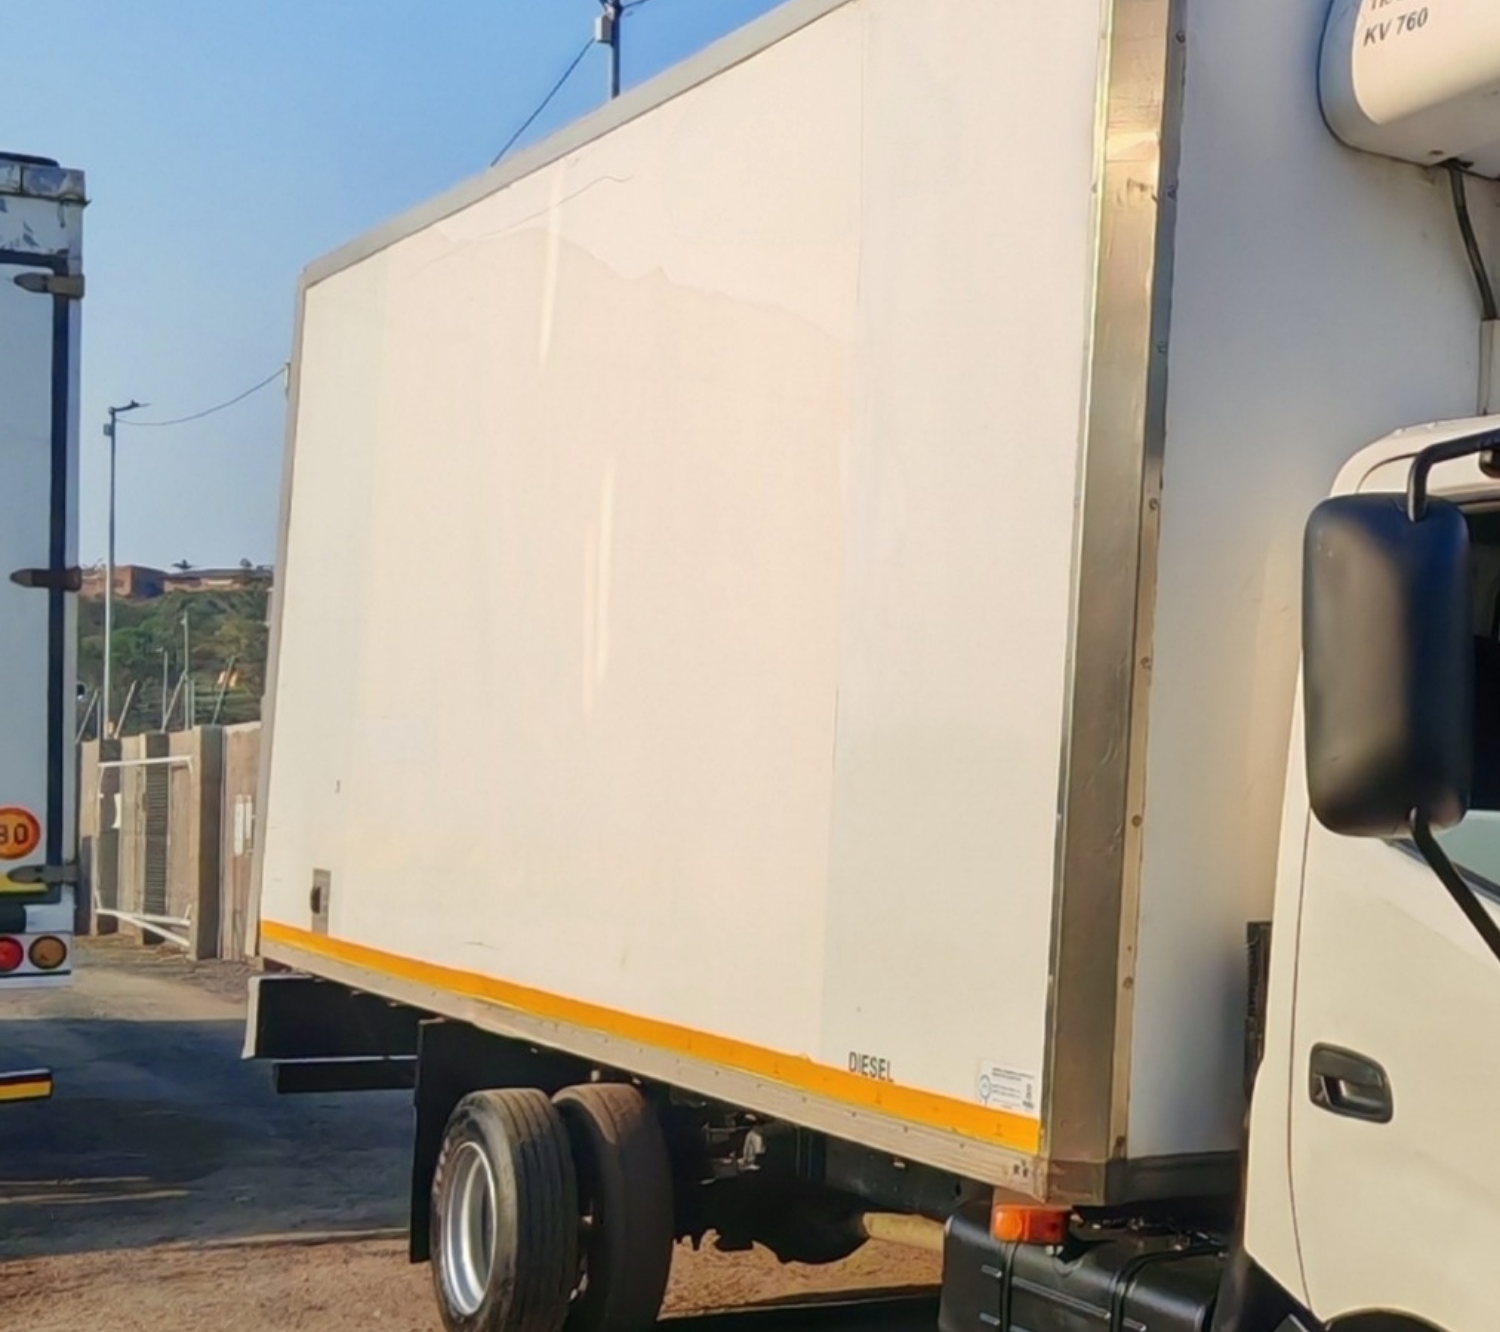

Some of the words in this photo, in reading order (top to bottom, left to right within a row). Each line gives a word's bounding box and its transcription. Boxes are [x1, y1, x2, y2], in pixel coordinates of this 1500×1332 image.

[1363, 18, 1392, 47] KV
[1396, 7, 1428, 35] 760
[848, 1050, 895, 1083] DIESEL
